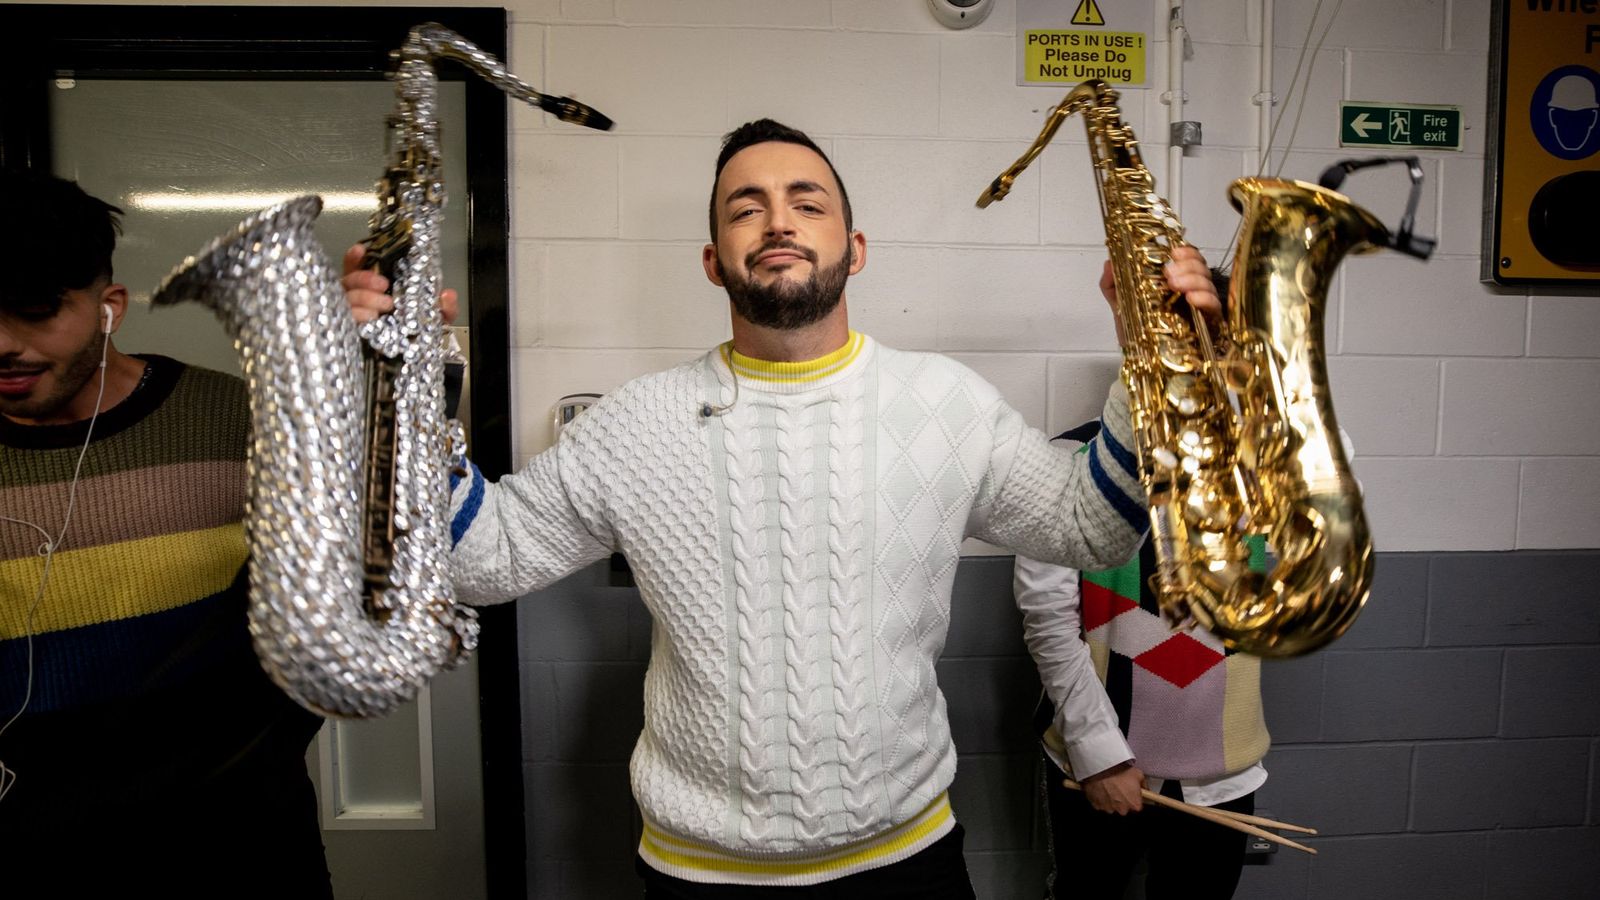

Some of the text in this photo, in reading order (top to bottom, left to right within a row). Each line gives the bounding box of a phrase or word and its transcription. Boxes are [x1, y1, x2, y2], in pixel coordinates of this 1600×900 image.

[1028, 34, 1080, 46] PORTS
[1084, 35, 1099, 46] IN
[1104, 35, 1133, 48] USE
[1045, 48, 1126, 63] Please Do
[1040, 64, 1131, 81] Not Unplug
[1423, 114, 1448, 127] Fire
[1423, 130, 1446, 142] exit
